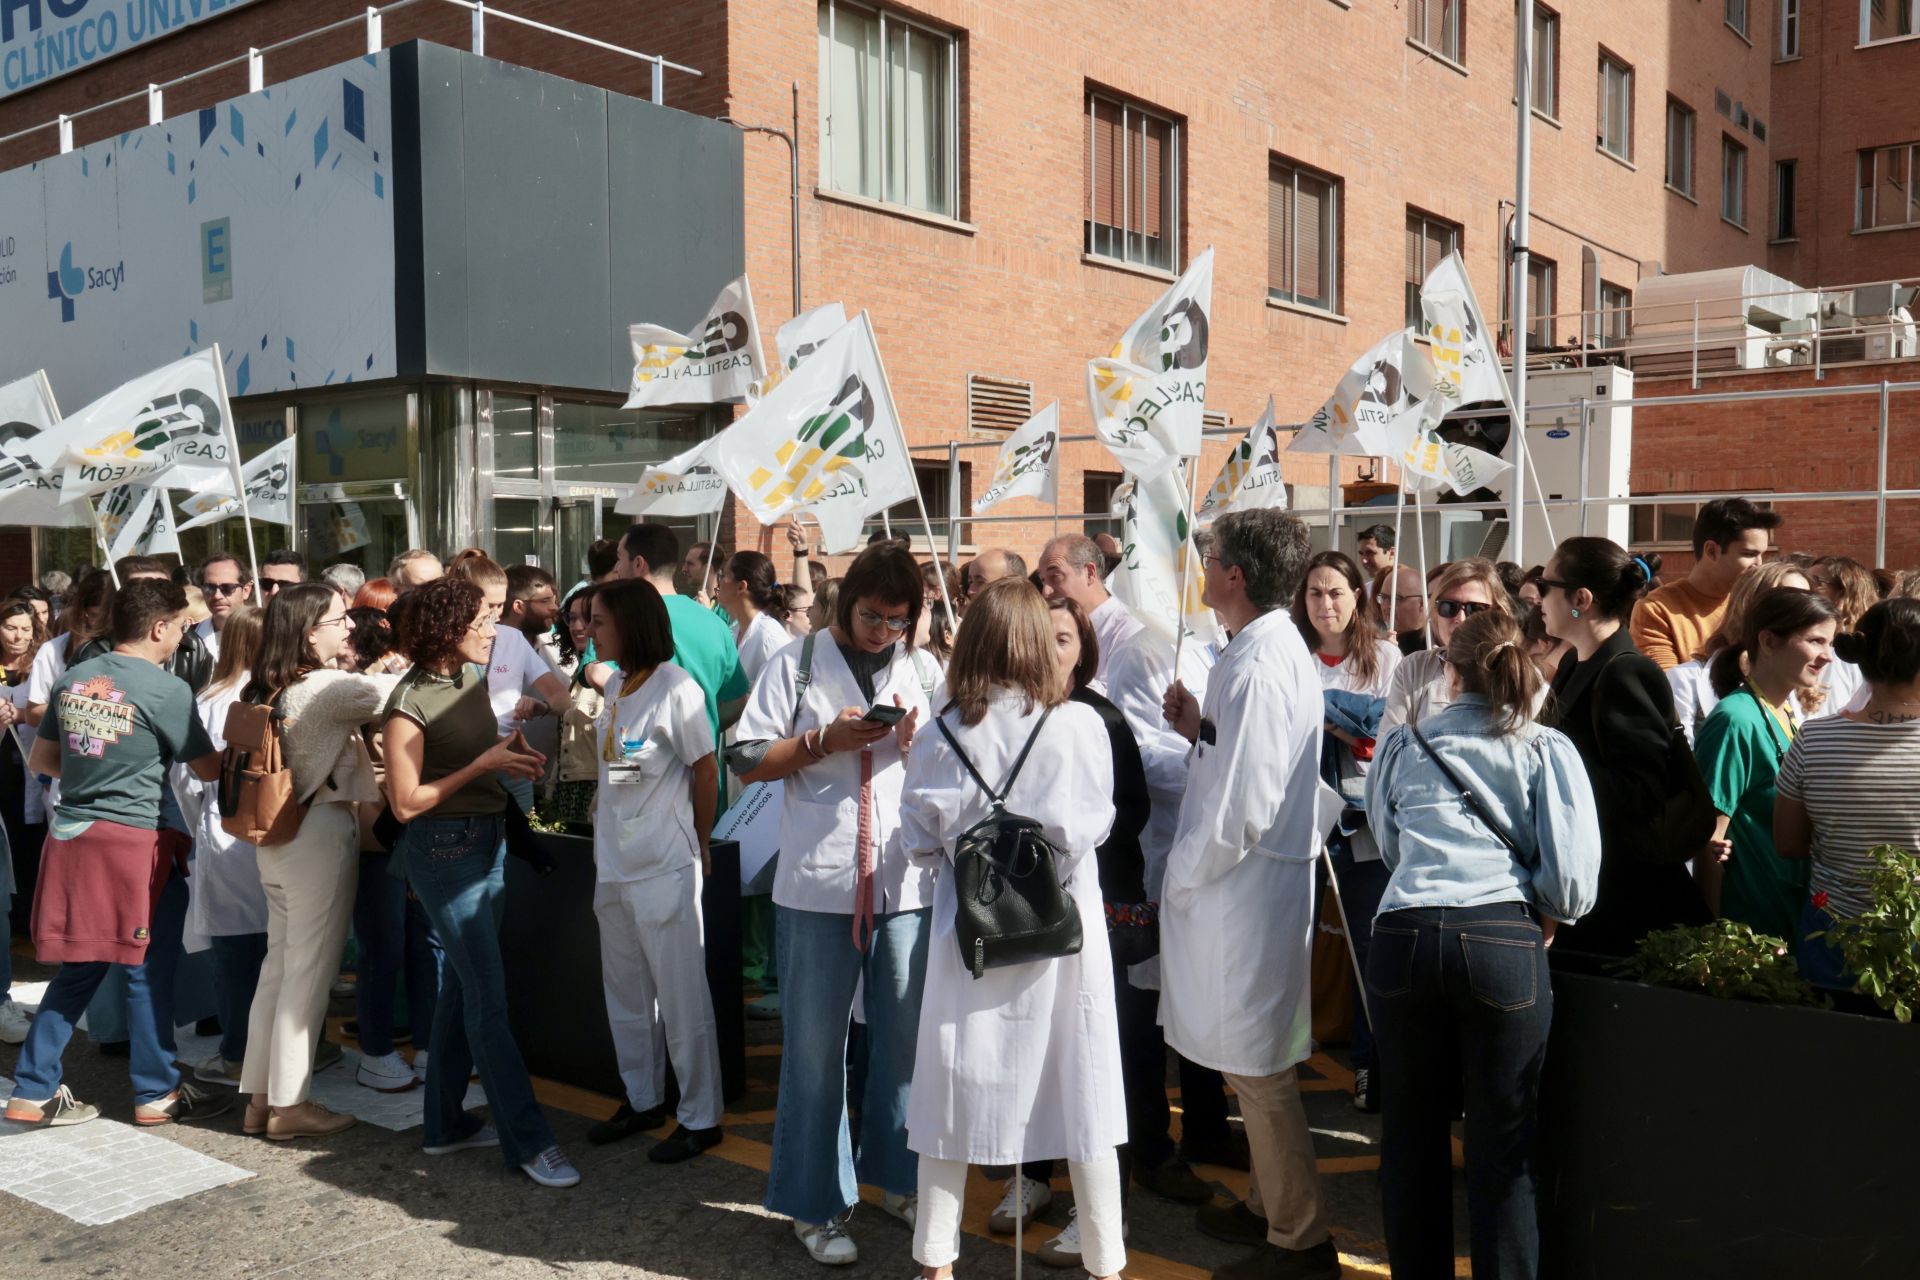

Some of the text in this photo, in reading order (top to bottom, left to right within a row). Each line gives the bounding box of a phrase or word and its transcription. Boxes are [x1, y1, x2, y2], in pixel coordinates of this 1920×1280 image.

[4, 10, 117, 90] CLÍNICO
[207, 227, 225, 273] E
[88, 261, 124, 291] Sacyl
[569, 486, 617, 498] ENTRADA
[58, 693, 128, 731] VOLCOM
[73, 719, 103, 736] STONE
[744, 792, 773, 826] MÉDICOS
[746, 782, 770, 810] PROPIO
